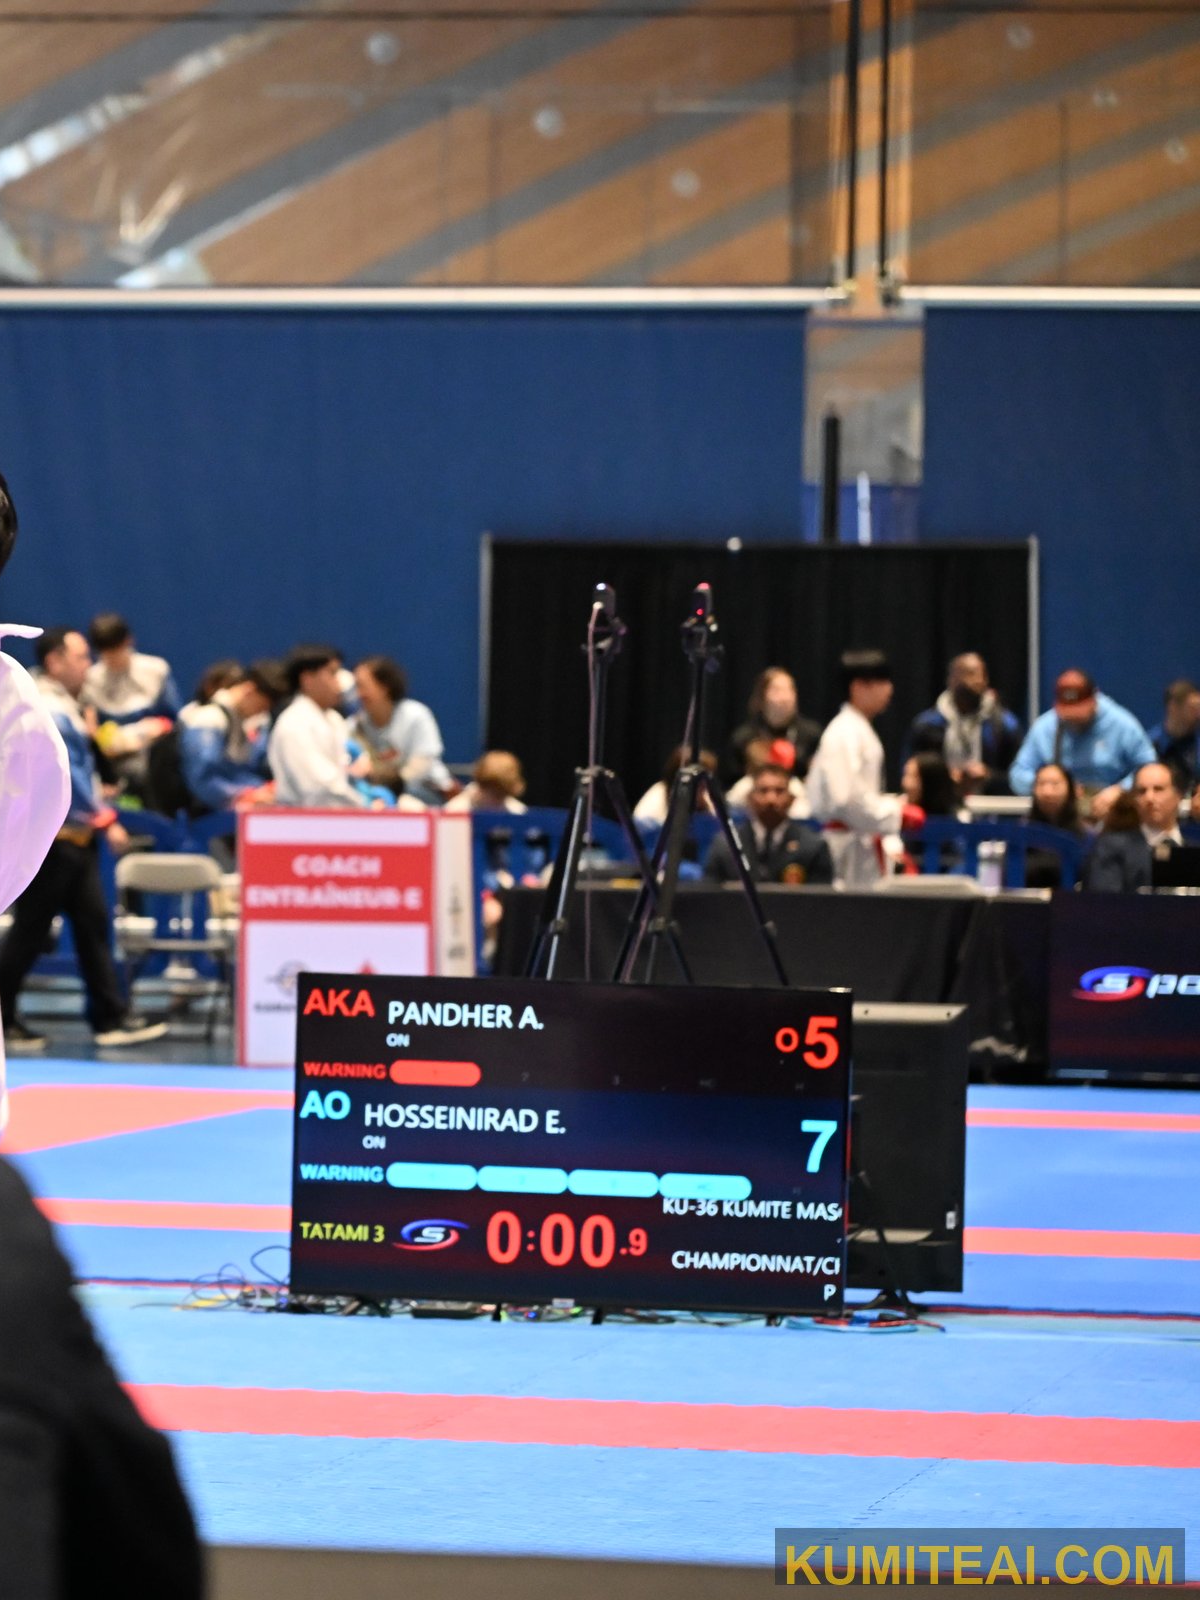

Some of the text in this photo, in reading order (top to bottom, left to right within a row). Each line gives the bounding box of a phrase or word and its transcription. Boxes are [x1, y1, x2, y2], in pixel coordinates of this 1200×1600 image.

[292, 855, 382, 878] COACH
[303, 988, 376, 1018] AKA
[388, 1001, 545, 1031] PANDHER A.
[386, 1033, 410, 1047] ON
[304, 1062, 386, 1079] WARNING
[299, 1090, 352, 1121] AO
[364, 1104, 567, 1135] HOSSEINIRAD E.
[362, 1135, 386, 1149] ON
[800, 1119, 839, 1174] 7
[299, 1163, 385, 1184] WARNING
[722, 1199, 793, 1220] KUMITE
[796, 1201, 843, 1223] MAS
[299, 1221, 386, 1244] TATAMI 3
